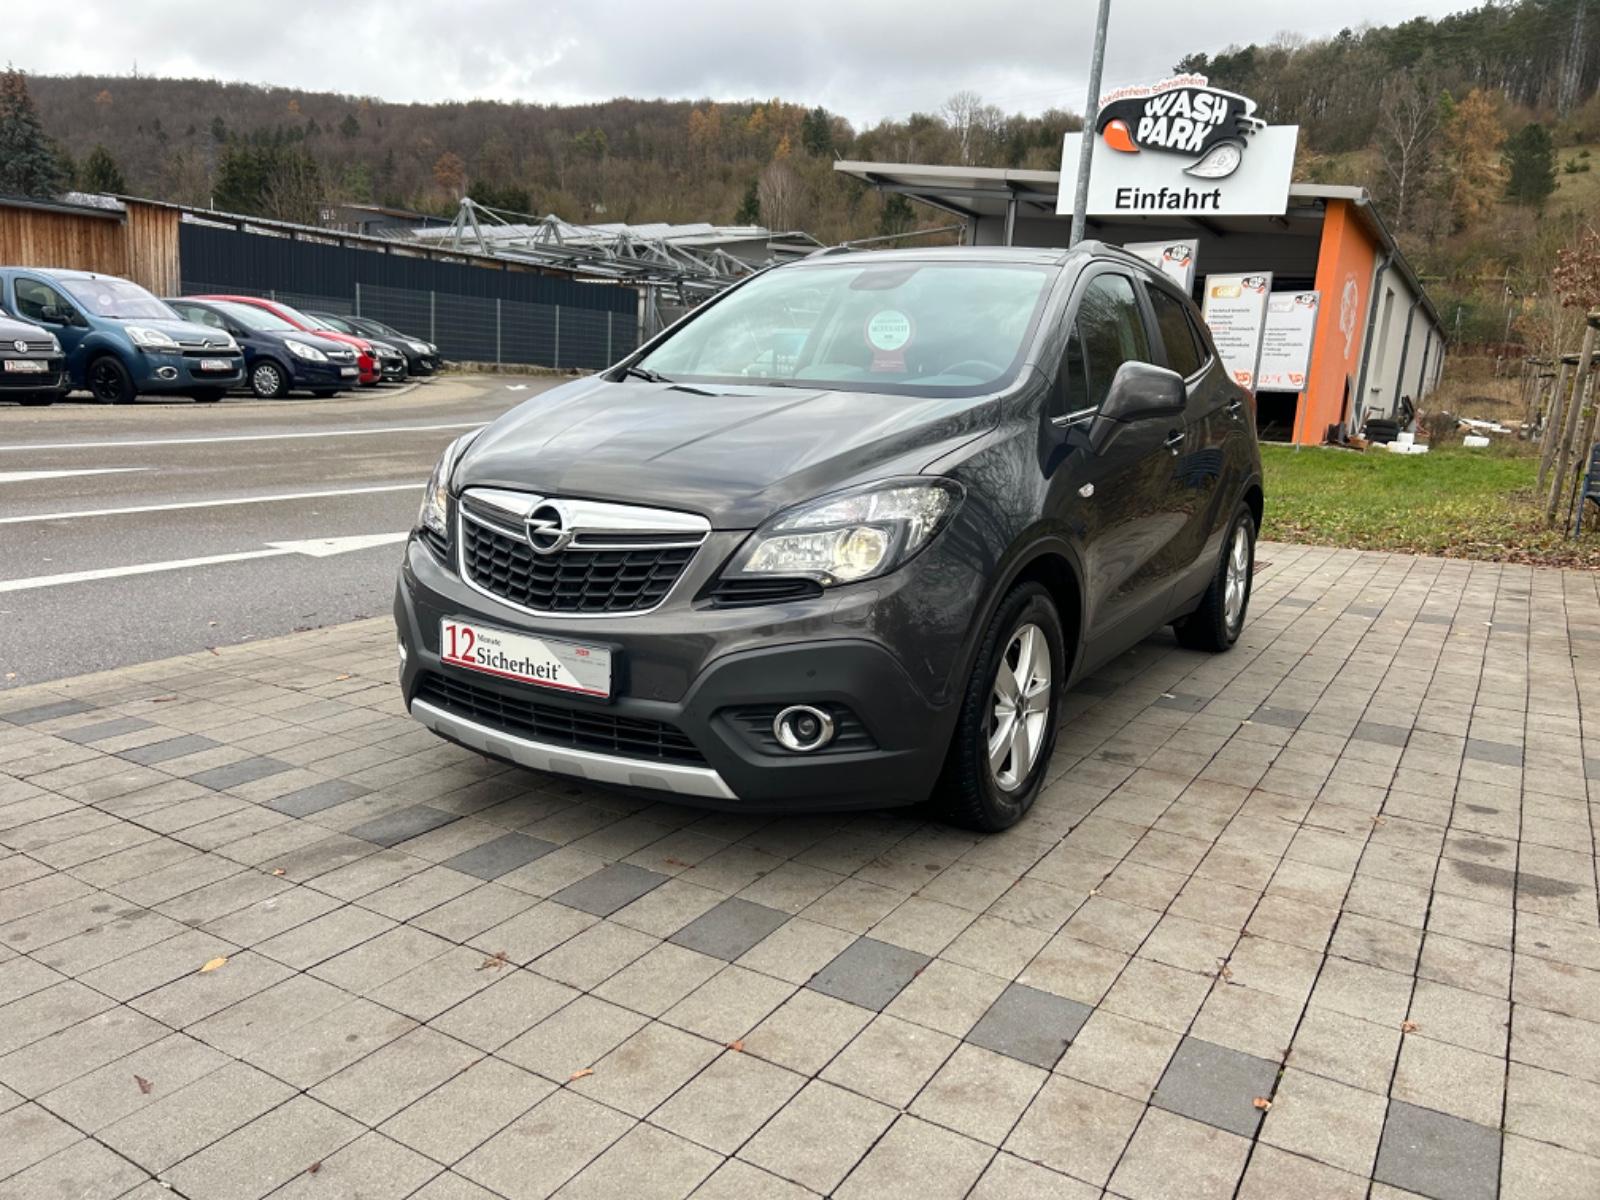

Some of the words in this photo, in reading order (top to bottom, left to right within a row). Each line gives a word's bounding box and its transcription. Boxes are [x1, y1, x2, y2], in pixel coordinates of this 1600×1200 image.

[1145, 90, 1228, 125] WASH
[1137, 116, 1213, 152] PARK
[1115, 187, 1221, 210] Einfahrt
[445, 624, 476, 663] 12
